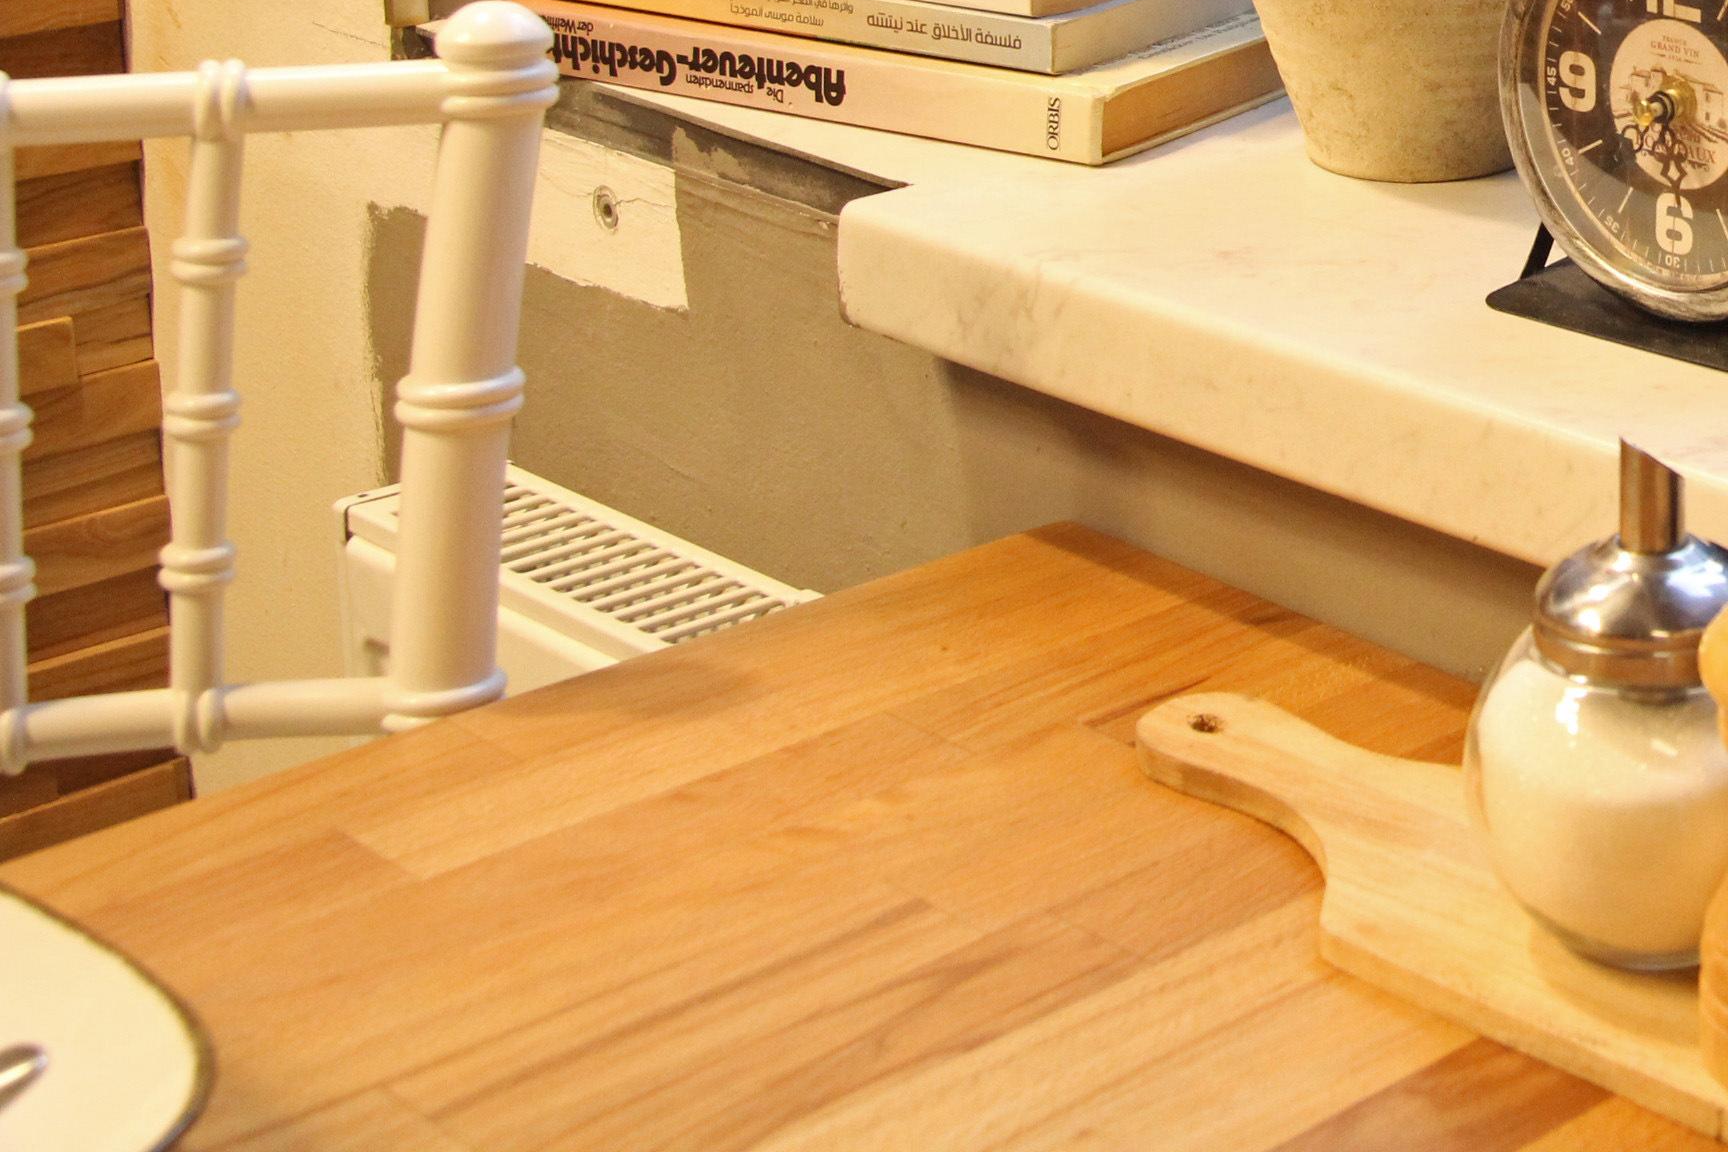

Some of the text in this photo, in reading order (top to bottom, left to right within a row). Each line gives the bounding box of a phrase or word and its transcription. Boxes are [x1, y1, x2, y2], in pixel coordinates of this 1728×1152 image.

[814, 0, 828, 9] في
[576, 20, 594, 36] der
[795, 14, 825, 27] سلامة
[906, 18, 929, 35] عند
[931, 22, 973, 43] الأخلاق
[974, 27, 1023, 50] فلسفة
[1650, 40, 1681, 54] GRAND
[1682, 47, 1700, 59] VIN
[546, 33, 847, 106] Abenteuer-Geschicht
[1546, 67, 1558, 87] 45
[686, 73, 785, 103] Die spannendsten
[1558, 50, 1597, 113] 9
[1046, 96, 1061, 152] ORBIS
[1560, 147, 1575, 167] 40
[1603, 215, 1621, 234] 35
[1655, 192, 1694, 256] 6
[1664, 255, 1681, 269] 30
